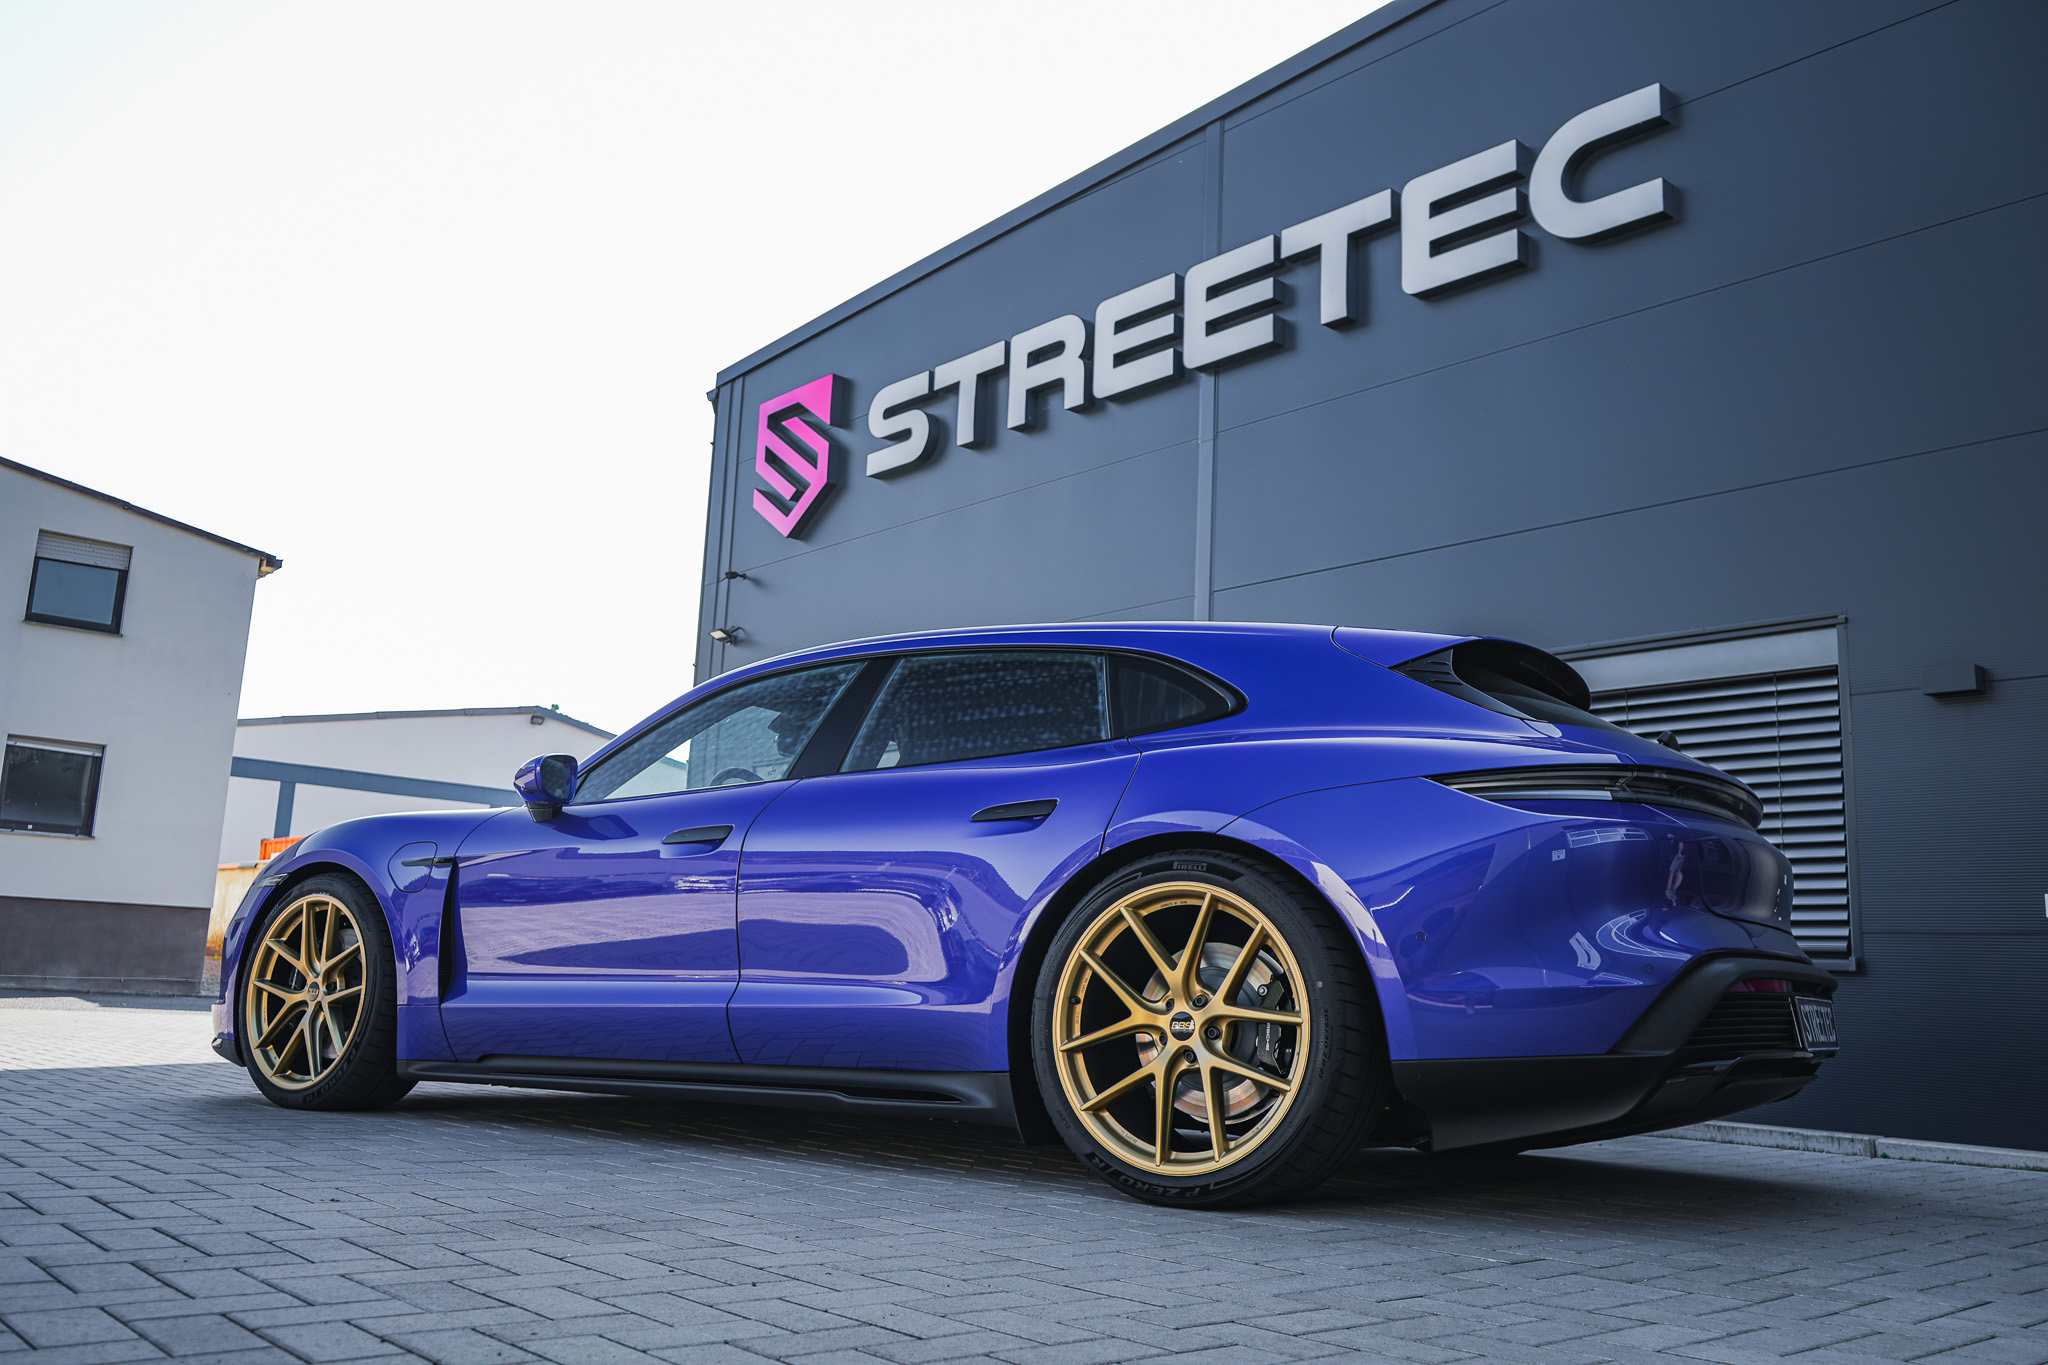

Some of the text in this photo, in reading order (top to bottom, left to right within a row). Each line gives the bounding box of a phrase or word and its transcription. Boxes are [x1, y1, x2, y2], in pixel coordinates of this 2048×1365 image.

[866, 82, 1674, 478] STREETEC
[1172, 860, 1208, 872] PIRELLI
[1171, 1020, 1192, 1030] BBS
[1800, 1004, 1837, 1042] STREETEC
[1090, 1156, 1200, 1197] P ZERO R
